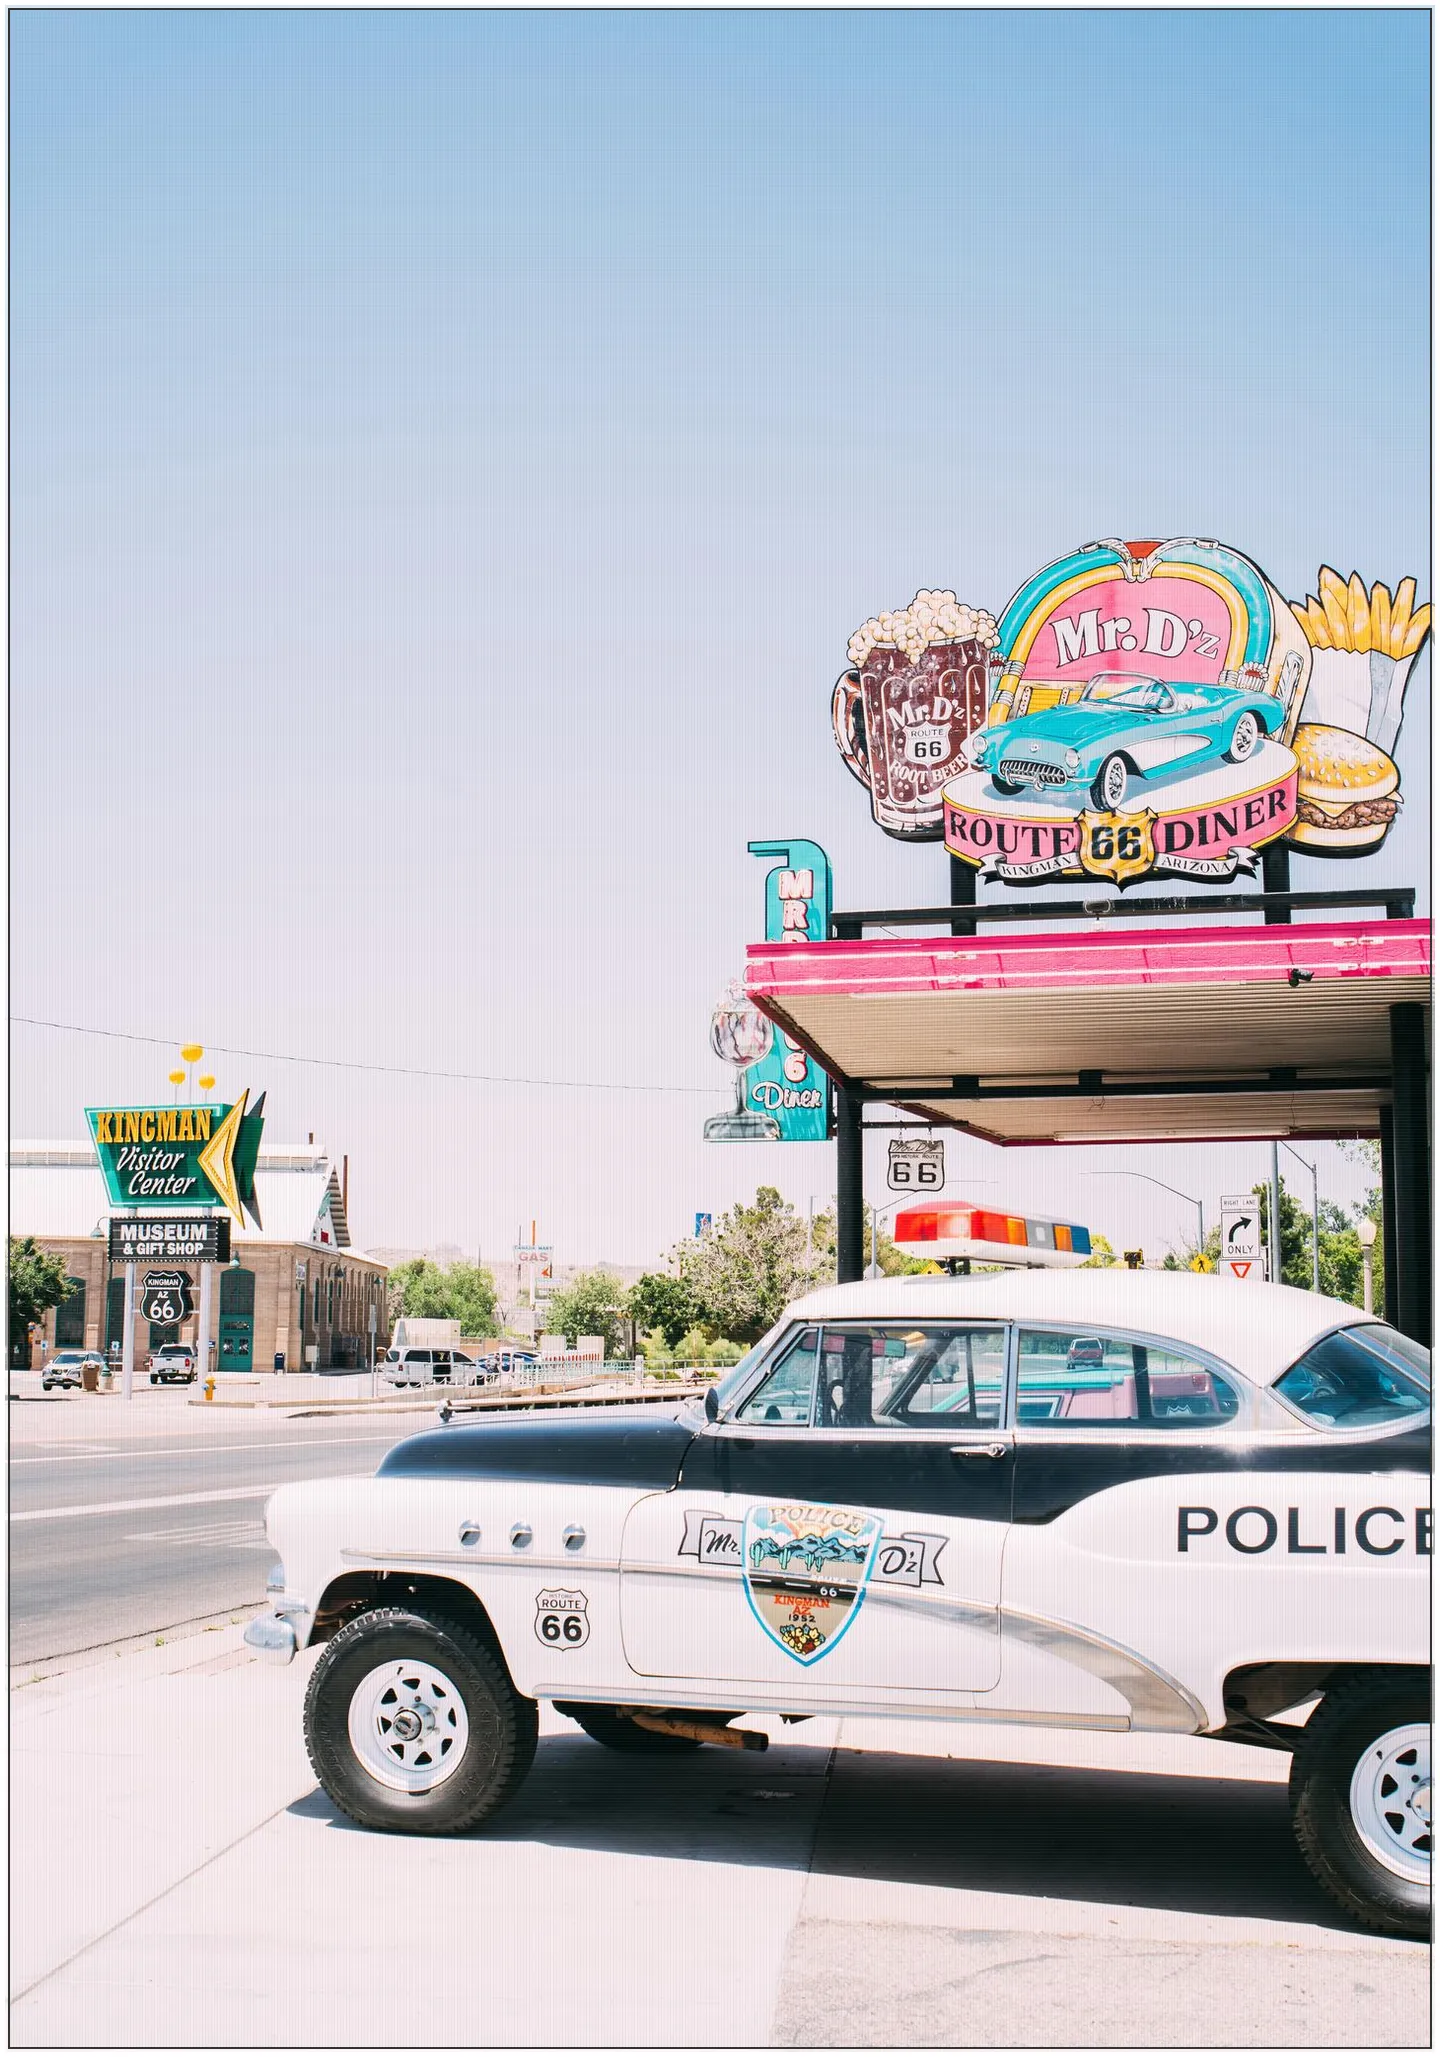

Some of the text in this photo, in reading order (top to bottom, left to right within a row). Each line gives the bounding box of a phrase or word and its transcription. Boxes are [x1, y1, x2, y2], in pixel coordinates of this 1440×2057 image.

[1049, 608, 1137, 667] Mr.
[887, 700, 931, 732] Mr.
[911, 729, 944, 737] ROUTE
[914, 741, 942, 758] 66
[890, 753, 969, 783] ROOT BEER
[950, 788, 1287, 860] ROUTE 66 DINER
[1001, 856, 1073, 877] KINGMAN
[1162, 858, 1233, 873] ARIZONA
[752, 1081, 823, 1110] Diner
[96, 1109, 211, 1143] KINGMAN
[116, 1146, 185, 1171] Visitor
[893, 1162, 937, 1183] 66
[128, 1171, 196, 1195] Center
[120, 1224, 208, 1240] MUSEUM
[122, 1242, 204, 1255] & GIFT SHOP
[519, 1252, 549, 1261] GAS
[1227, 1245, 1254, 1254] ONLY
[147, 1278, 179, 1286] KINGMAN
[157, 1290, 169, 1299] AZ
[150, 1299, 175, 1319] 66
[771, 1507, 865, 1536] POLICE
[705, 1530, 742, 1556] Mr.
[819, 1586, 838, 1597] 66
[542, 1599, 581, 1609] ROUTE
[774, 1593, 831, 1609] KINGMAN
[788, 1613, 817, 1623] 1952
[793, 1606, 811, 1615] AZ
[542, 1614, 582, 1642] 66
